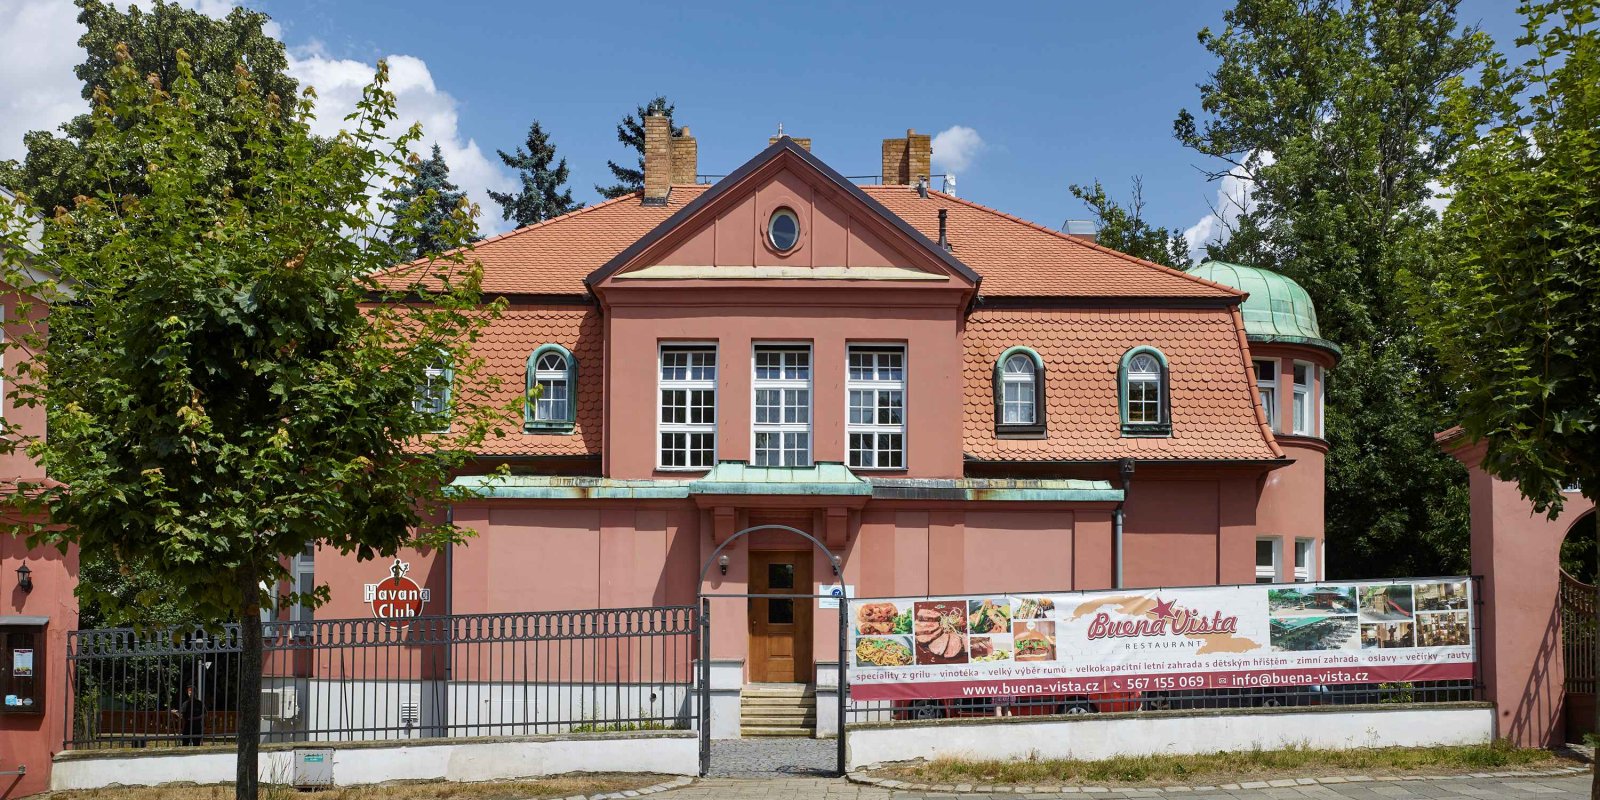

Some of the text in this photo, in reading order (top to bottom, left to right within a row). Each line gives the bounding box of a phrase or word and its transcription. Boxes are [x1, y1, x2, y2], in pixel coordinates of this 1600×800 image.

[364, 584, 430, 601] Havana
[379, 603, 415, 618] Club
[1087, 607, 1239, 640] Buena Vista
[1125, 640, 1202, 650] RESTAURANT
[856, 671, 899, 681] speciality
[909, 670, 931, 680] grilu
[940, 668, 979, 677] vinotéka
[988, 666, 1012, 676] velký
[1015, 666, 1040, 676] výběr
[1043, 665, 1067, 674] rumů
[1076, 662, 1141, 673] velkokapacitní
[1144, 661, 1165, 670] letní
[1167, 660, 1202, 670] zahrada
[1213, 658, 1251, 669] dětským
[1253, 656, 1287, 667] hřištěm
[1297, 655, 1321, 665] zimní
[1323, 655, 1359, 664] zahrada
[1368, 653, 1397, 664] oslavy
[1447, 650, 1471, 660] rauty
[962, 671, 1369, 696] www.buena-vista.cz 567 155 069 info@buena-vista.cz
